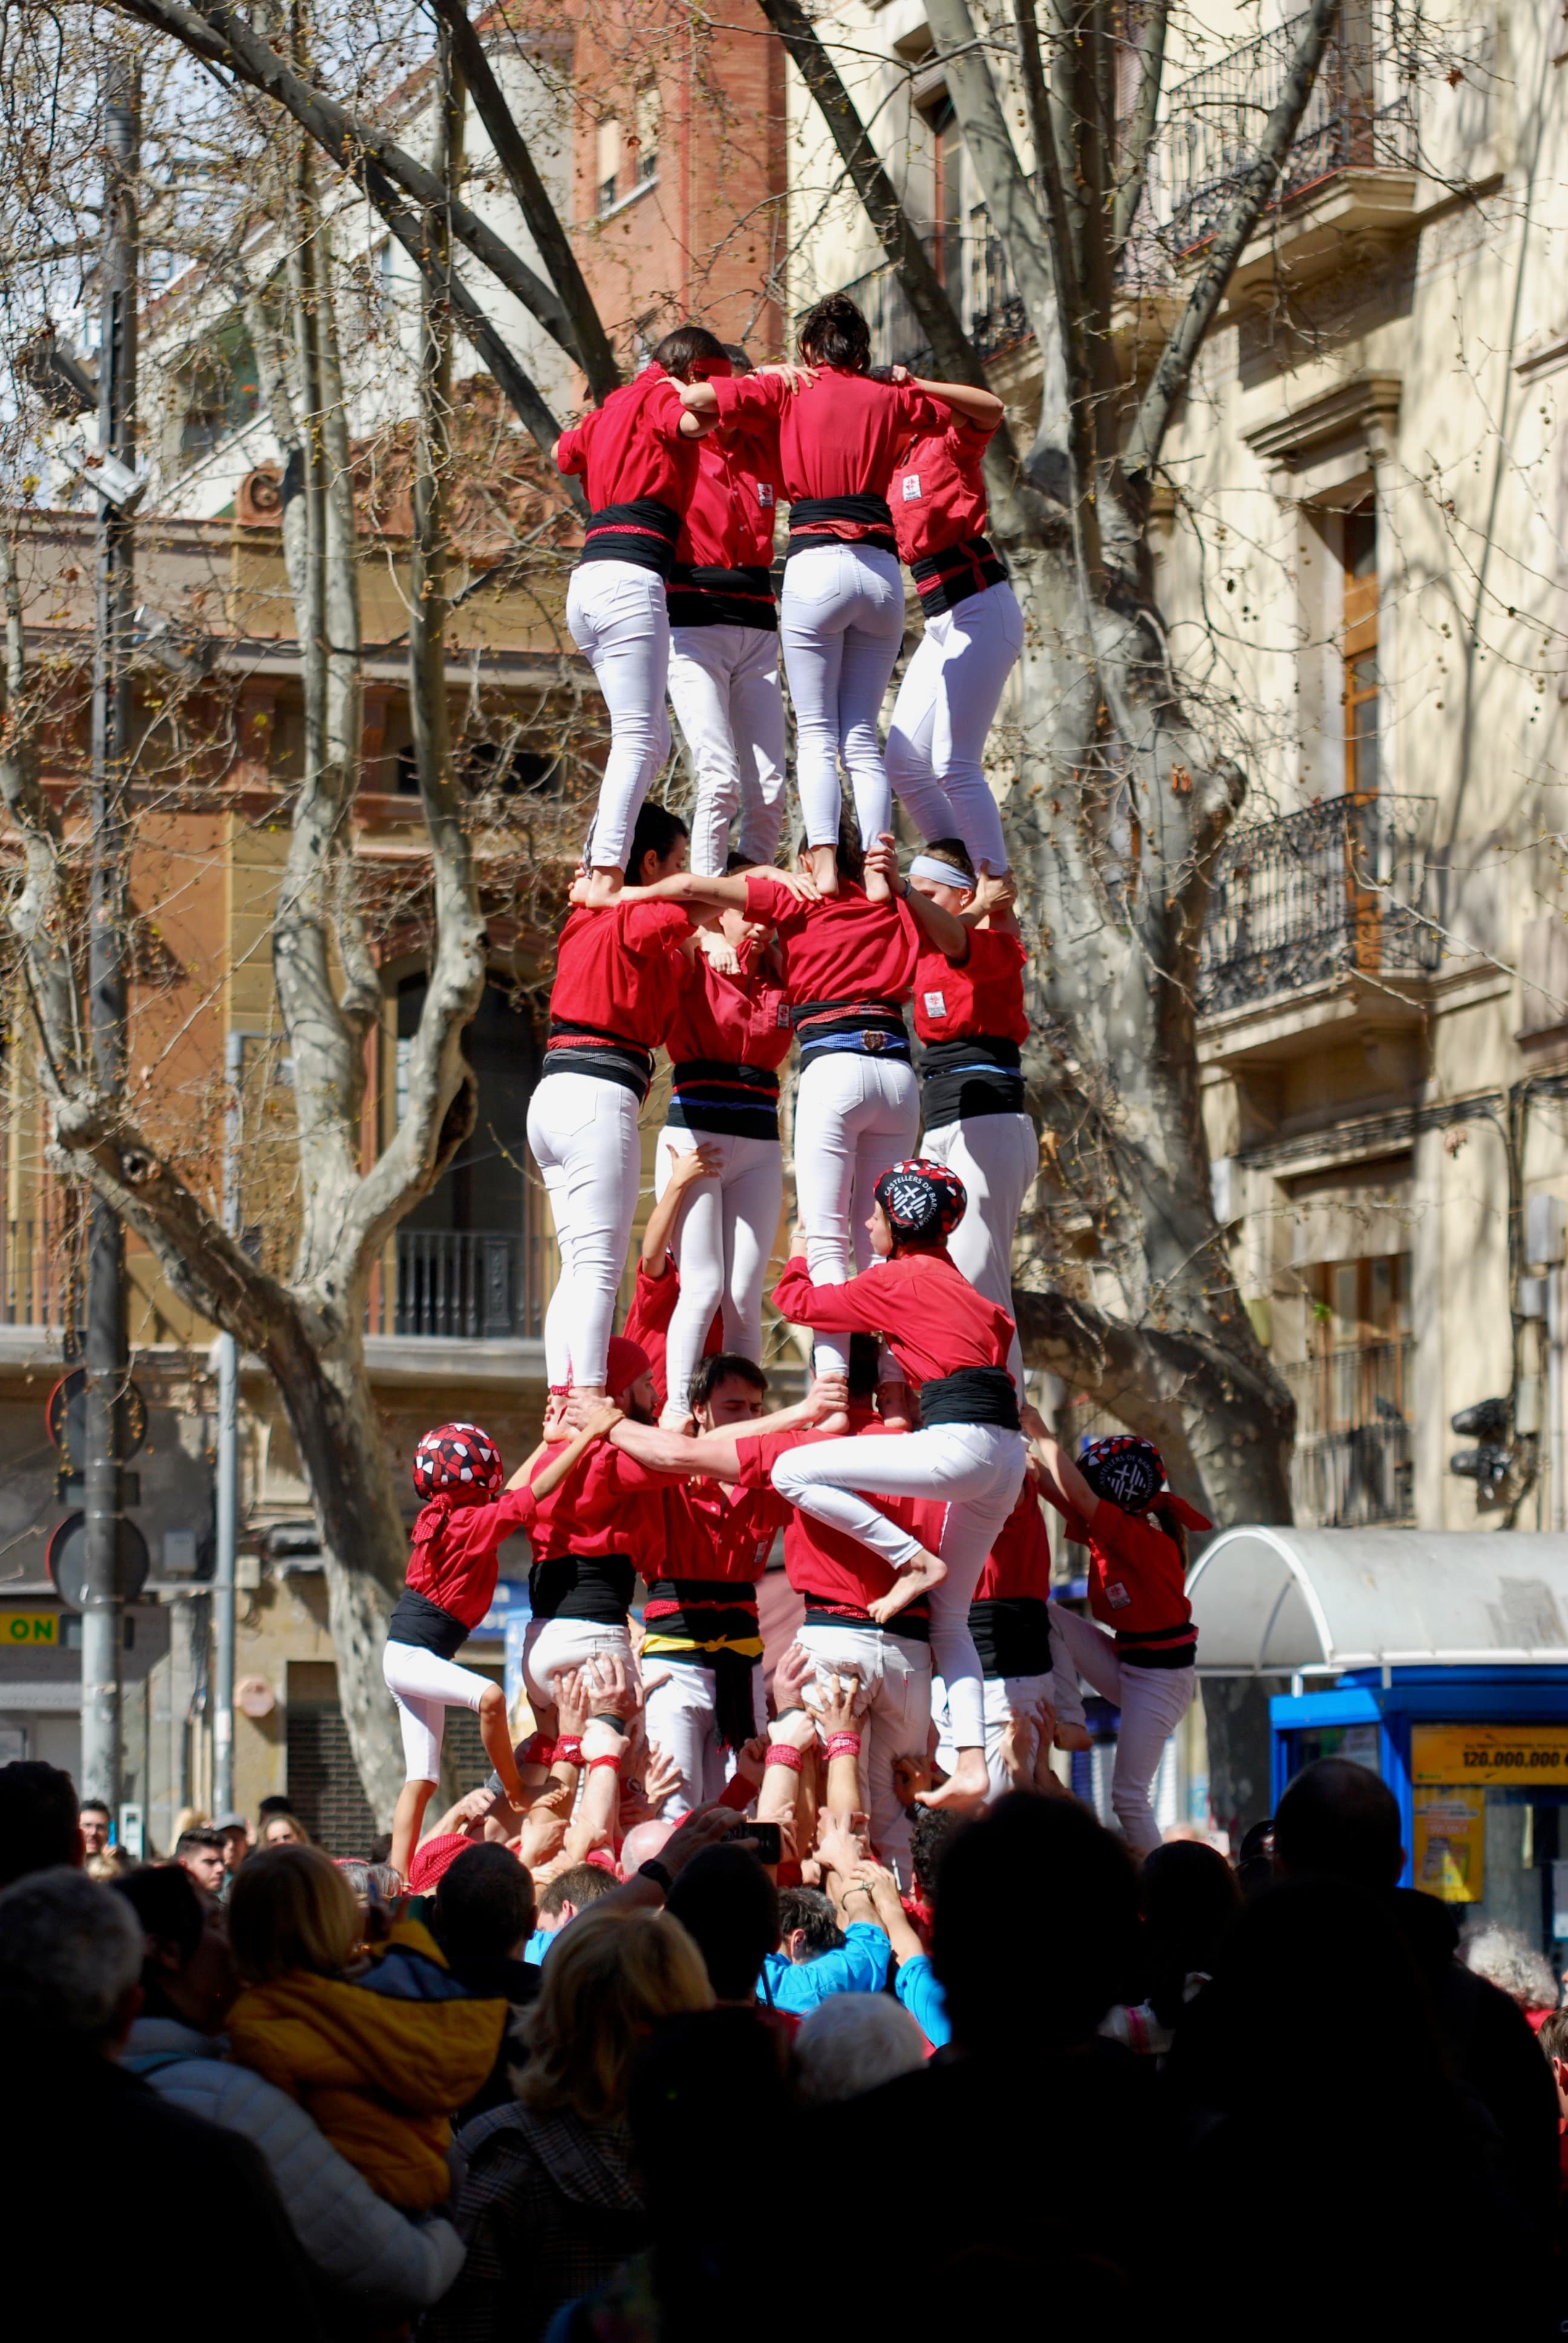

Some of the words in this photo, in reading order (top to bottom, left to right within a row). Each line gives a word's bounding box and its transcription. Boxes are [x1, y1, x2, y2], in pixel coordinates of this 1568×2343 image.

[884, 1175, 923, 1196] CASTELLERS
[923, 1182, 933, 1192] DE
[1099, 1455, 1125, 1490] CASTELLERS
[1137, 1457, 1153, 1498] BARCELONA
[1463, 1751, 1560, 1767] 120.000.000
